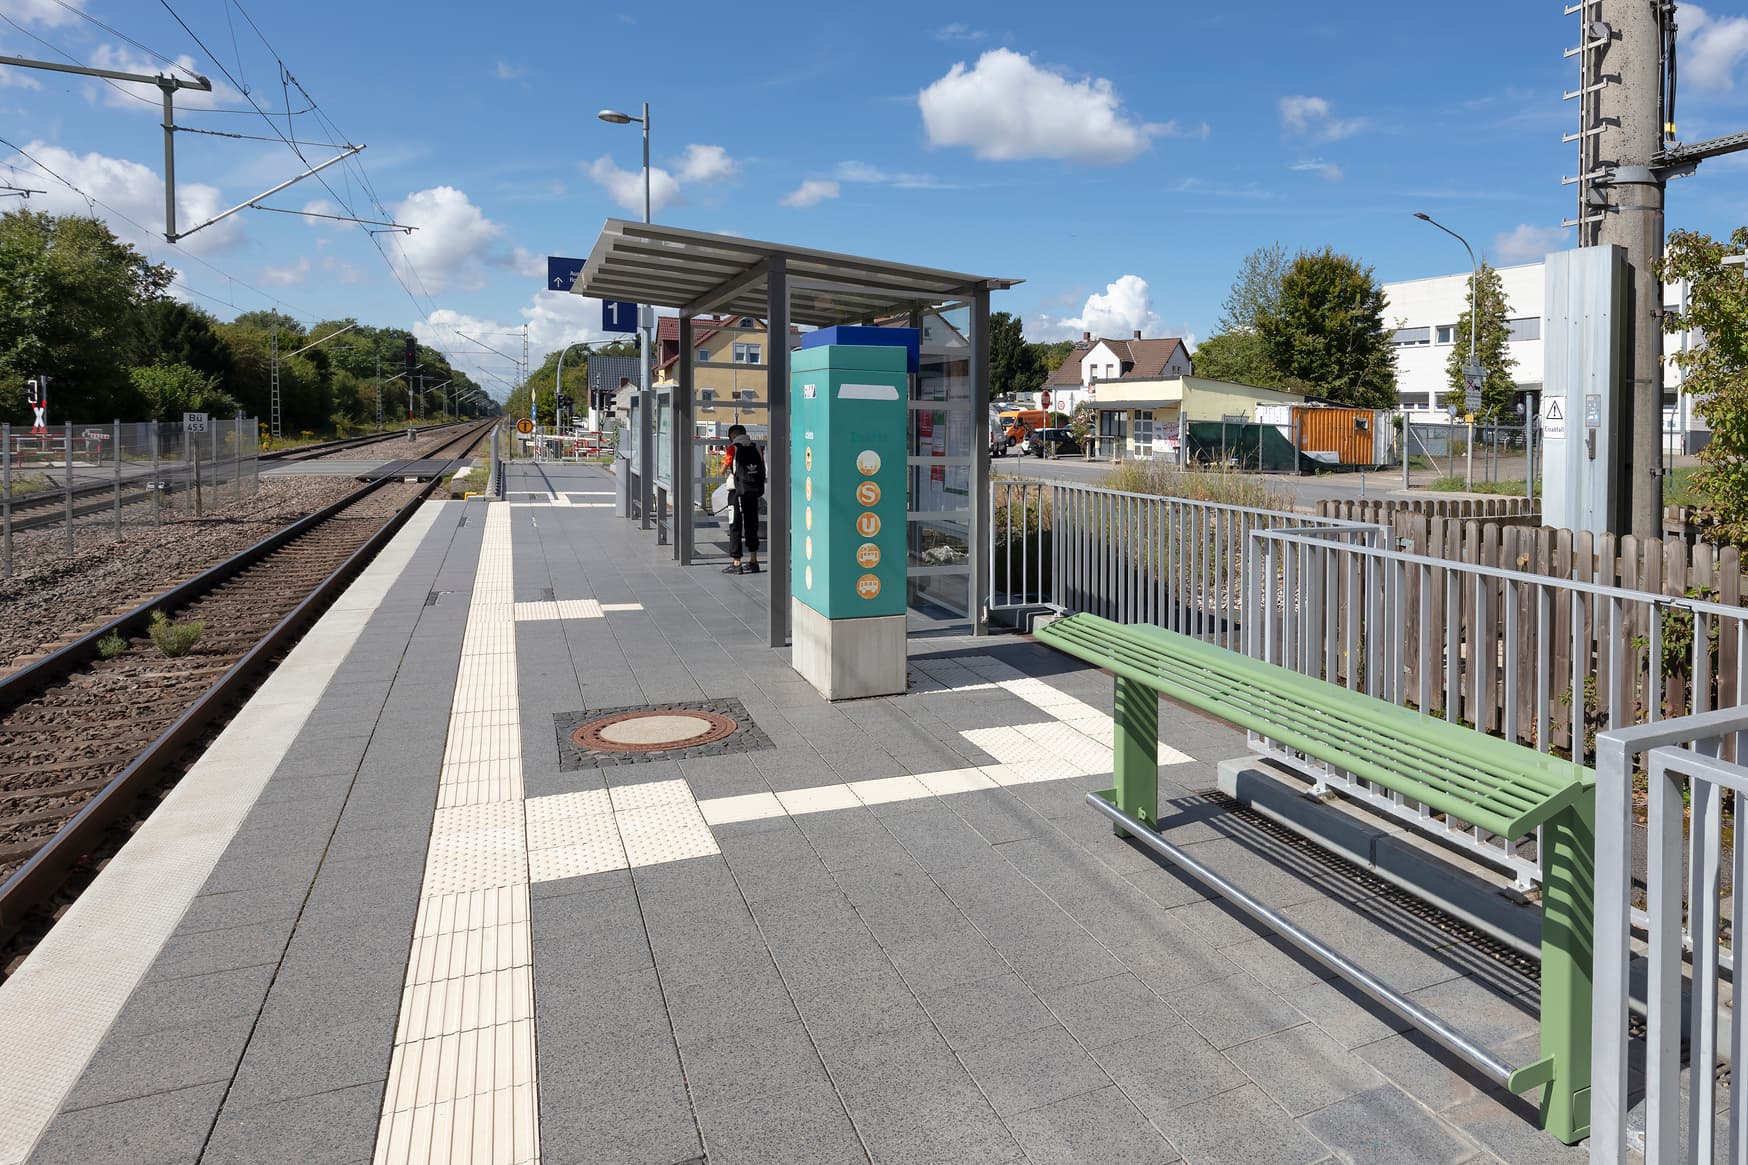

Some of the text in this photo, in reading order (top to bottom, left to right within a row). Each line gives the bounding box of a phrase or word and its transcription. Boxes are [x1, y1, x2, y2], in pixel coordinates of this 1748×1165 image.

[607, 302, 618, 325] 1
[861, 485, 876, 503] S
[862, 517, 876, 533] U
